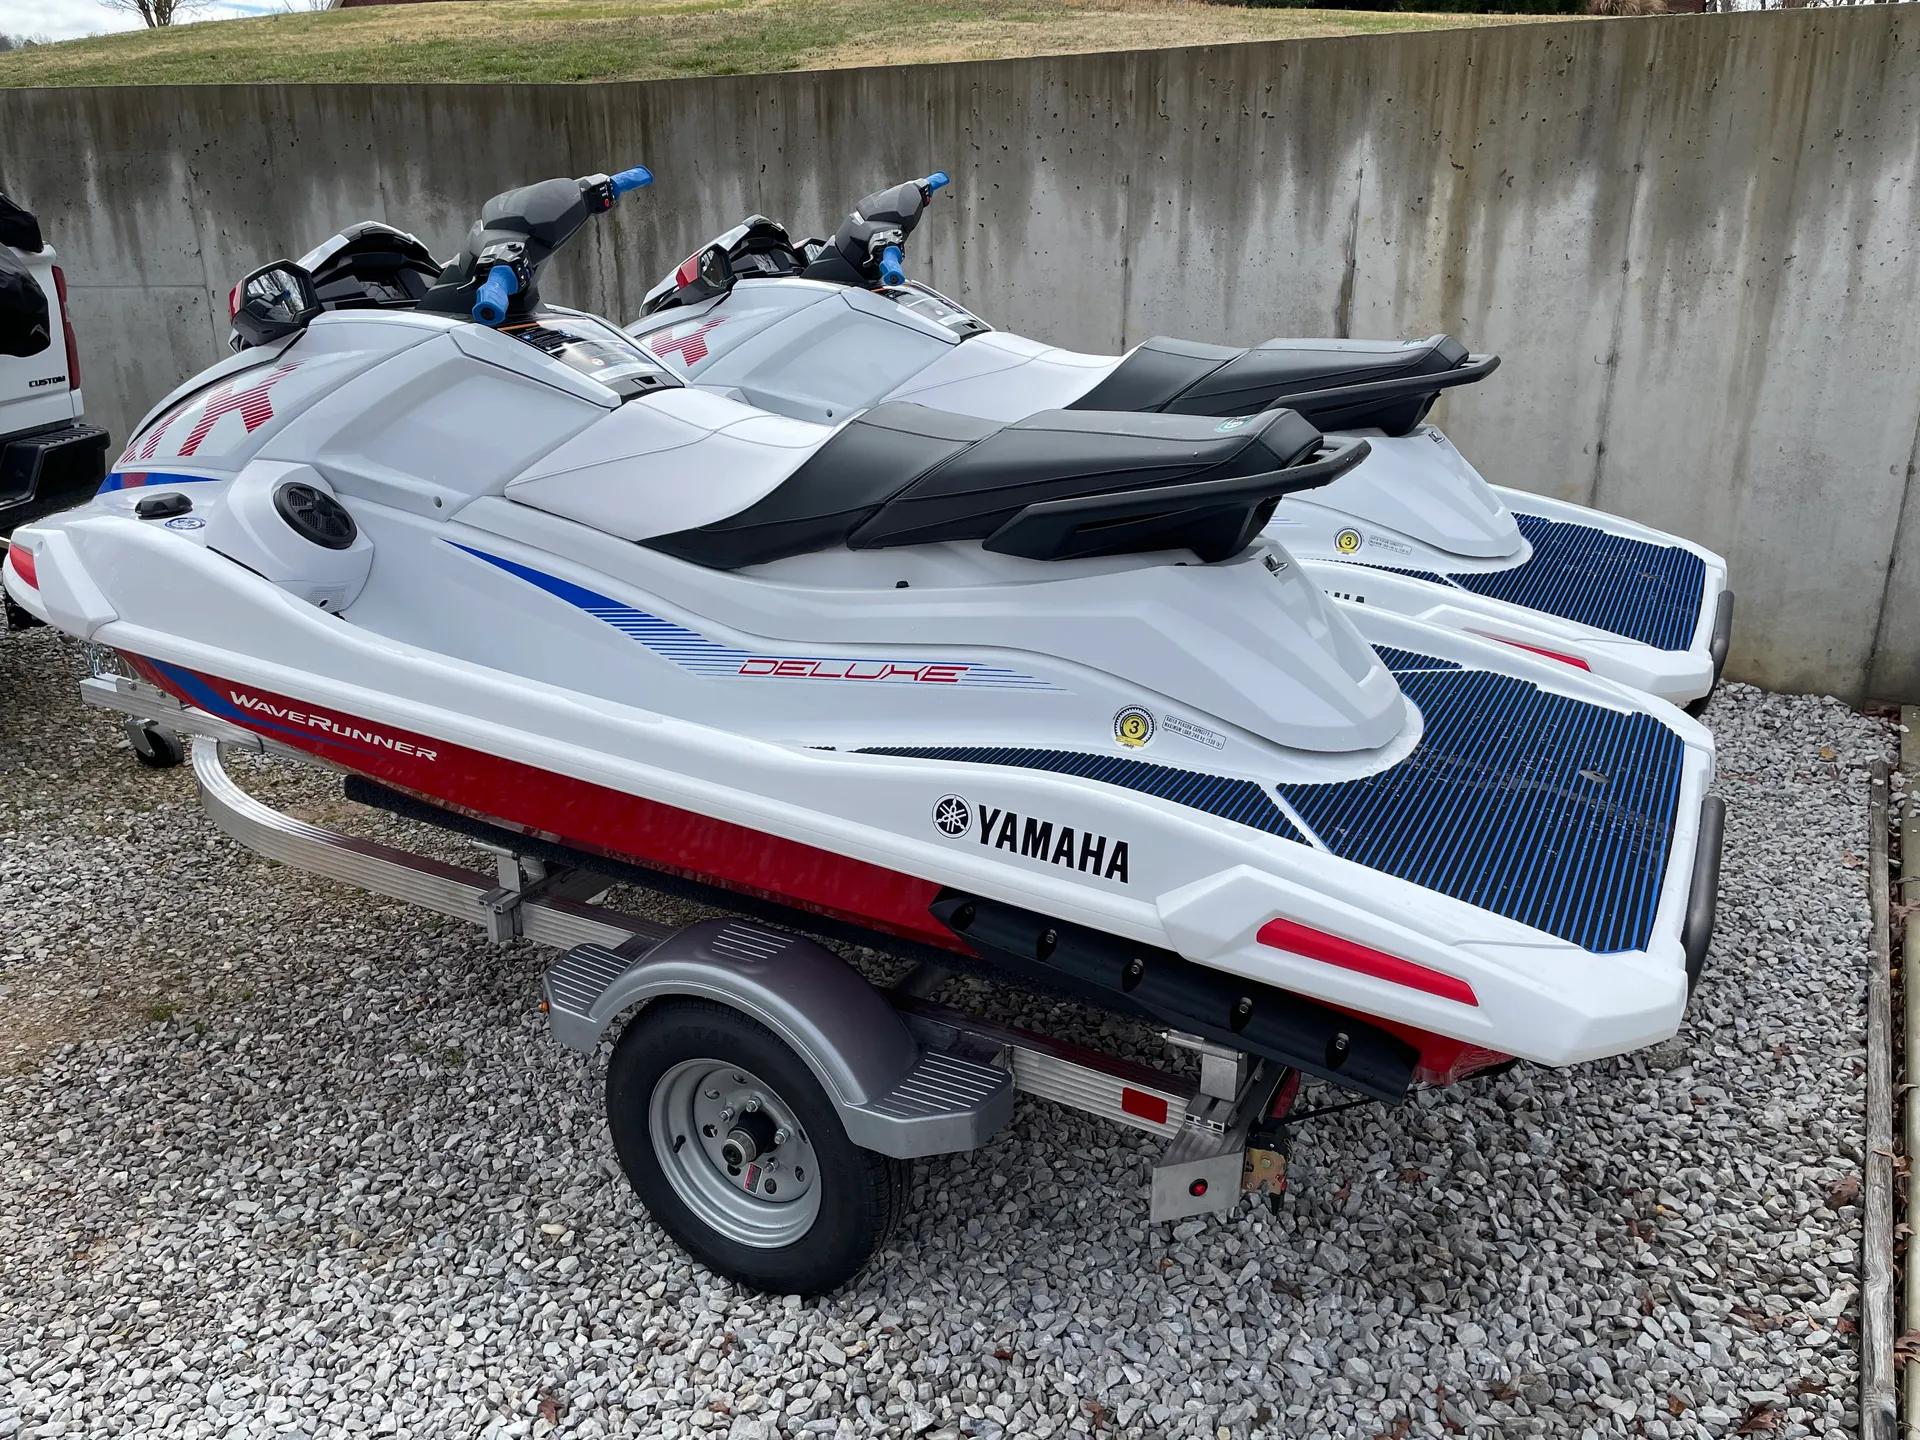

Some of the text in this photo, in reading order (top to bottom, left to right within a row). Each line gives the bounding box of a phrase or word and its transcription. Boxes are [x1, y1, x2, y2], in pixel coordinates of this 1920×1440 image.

[28, 375, 66, 388] CUSTOM
[1344, 536, 1353, 546] 3
[738, 659, 970, 683] DELUXE
[1129, 720, 1140, 734] 3
[978, 804, 1129, 884] YAMAHA
